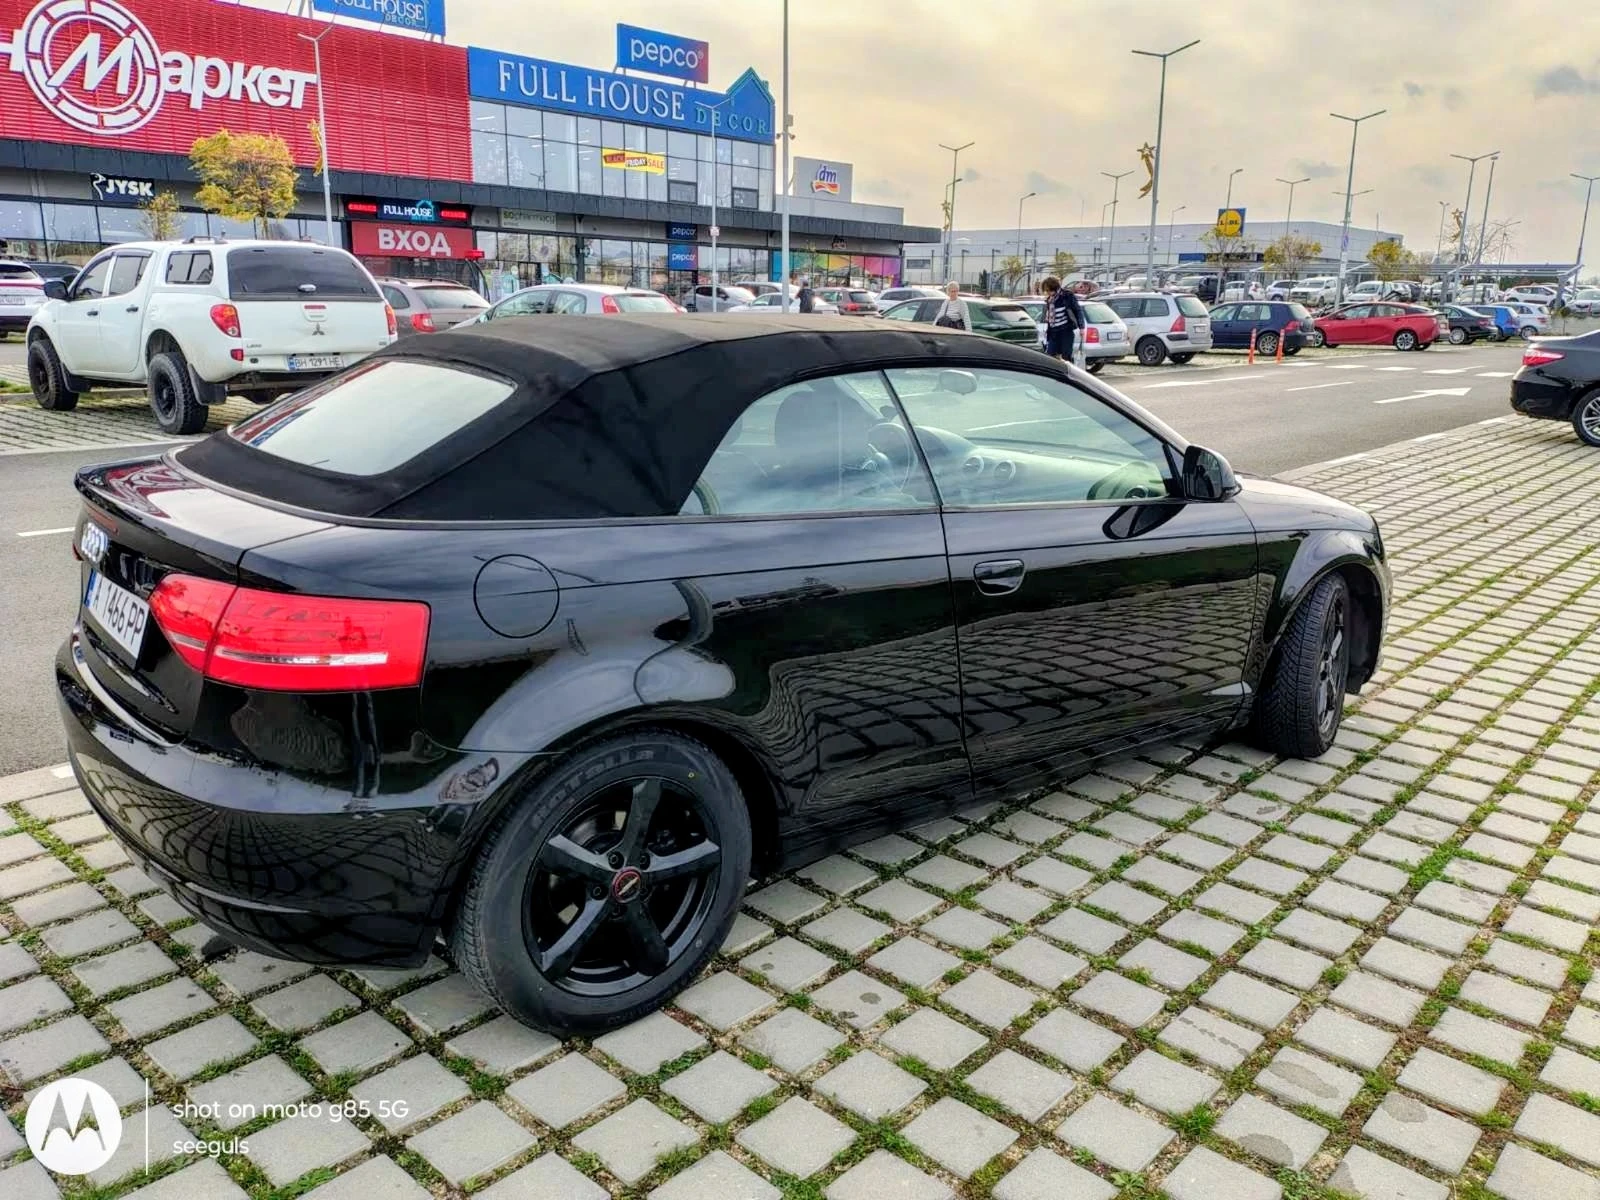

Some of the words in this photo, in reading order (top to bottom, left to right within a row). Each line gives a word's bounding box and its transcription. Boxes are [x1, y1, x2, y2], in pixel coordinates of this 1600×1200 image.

[373, 0, 424, 20] HOUSE
[498, 59, 577, 104] FULL
[587, 74, 685, 121] HOUSE
[695, 106, 767, 135] DECOR
[625, 158, 647, 167] FRIDAY
[647, 159, 665, 169] SALE
[818, 165, 838, 183] dm
[105, 179, 154, 197] JYSK
[383, 204, 403, 215] FULL
[404, 206, 433, 218] HOUSE
[377, 228, 452, 257] ВХОД
[102, 582, 128, 634] 1466
[124, 602, 145, 646] PP
